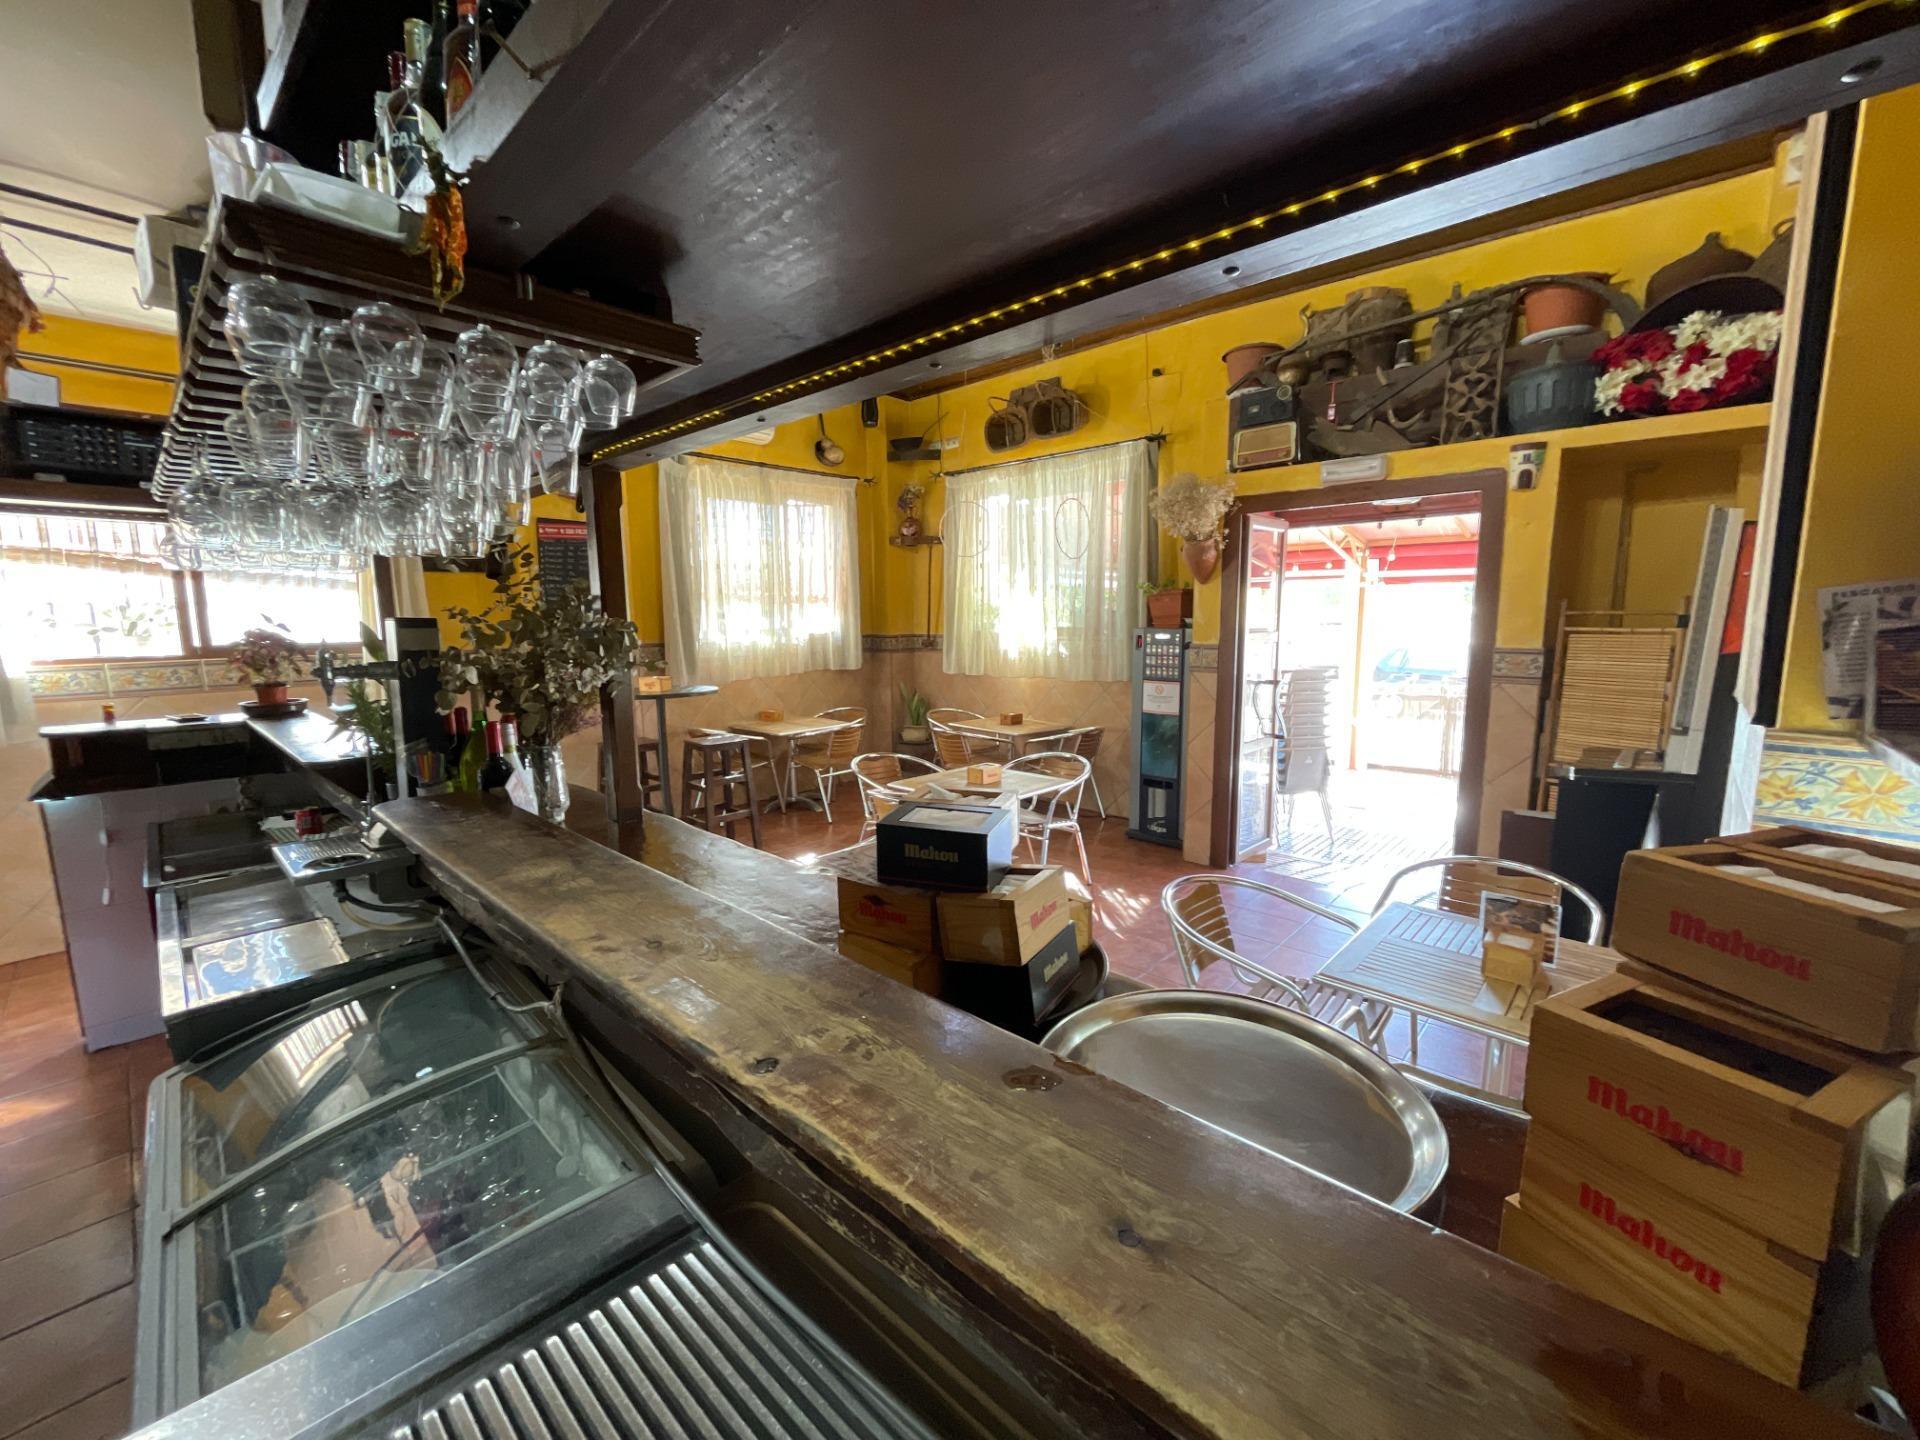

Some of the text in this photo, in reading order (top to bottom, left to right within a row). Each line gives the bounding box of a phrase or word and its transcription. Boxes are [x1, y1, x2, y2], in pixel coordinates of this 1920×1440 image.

[904, 843, 960, 863] Mahou
[1668, 909, 1812, 981] Mahou
[1587, 1075, 1745, 1174] Mahou
[1579, 1182, 1723, 1294] Mahou
